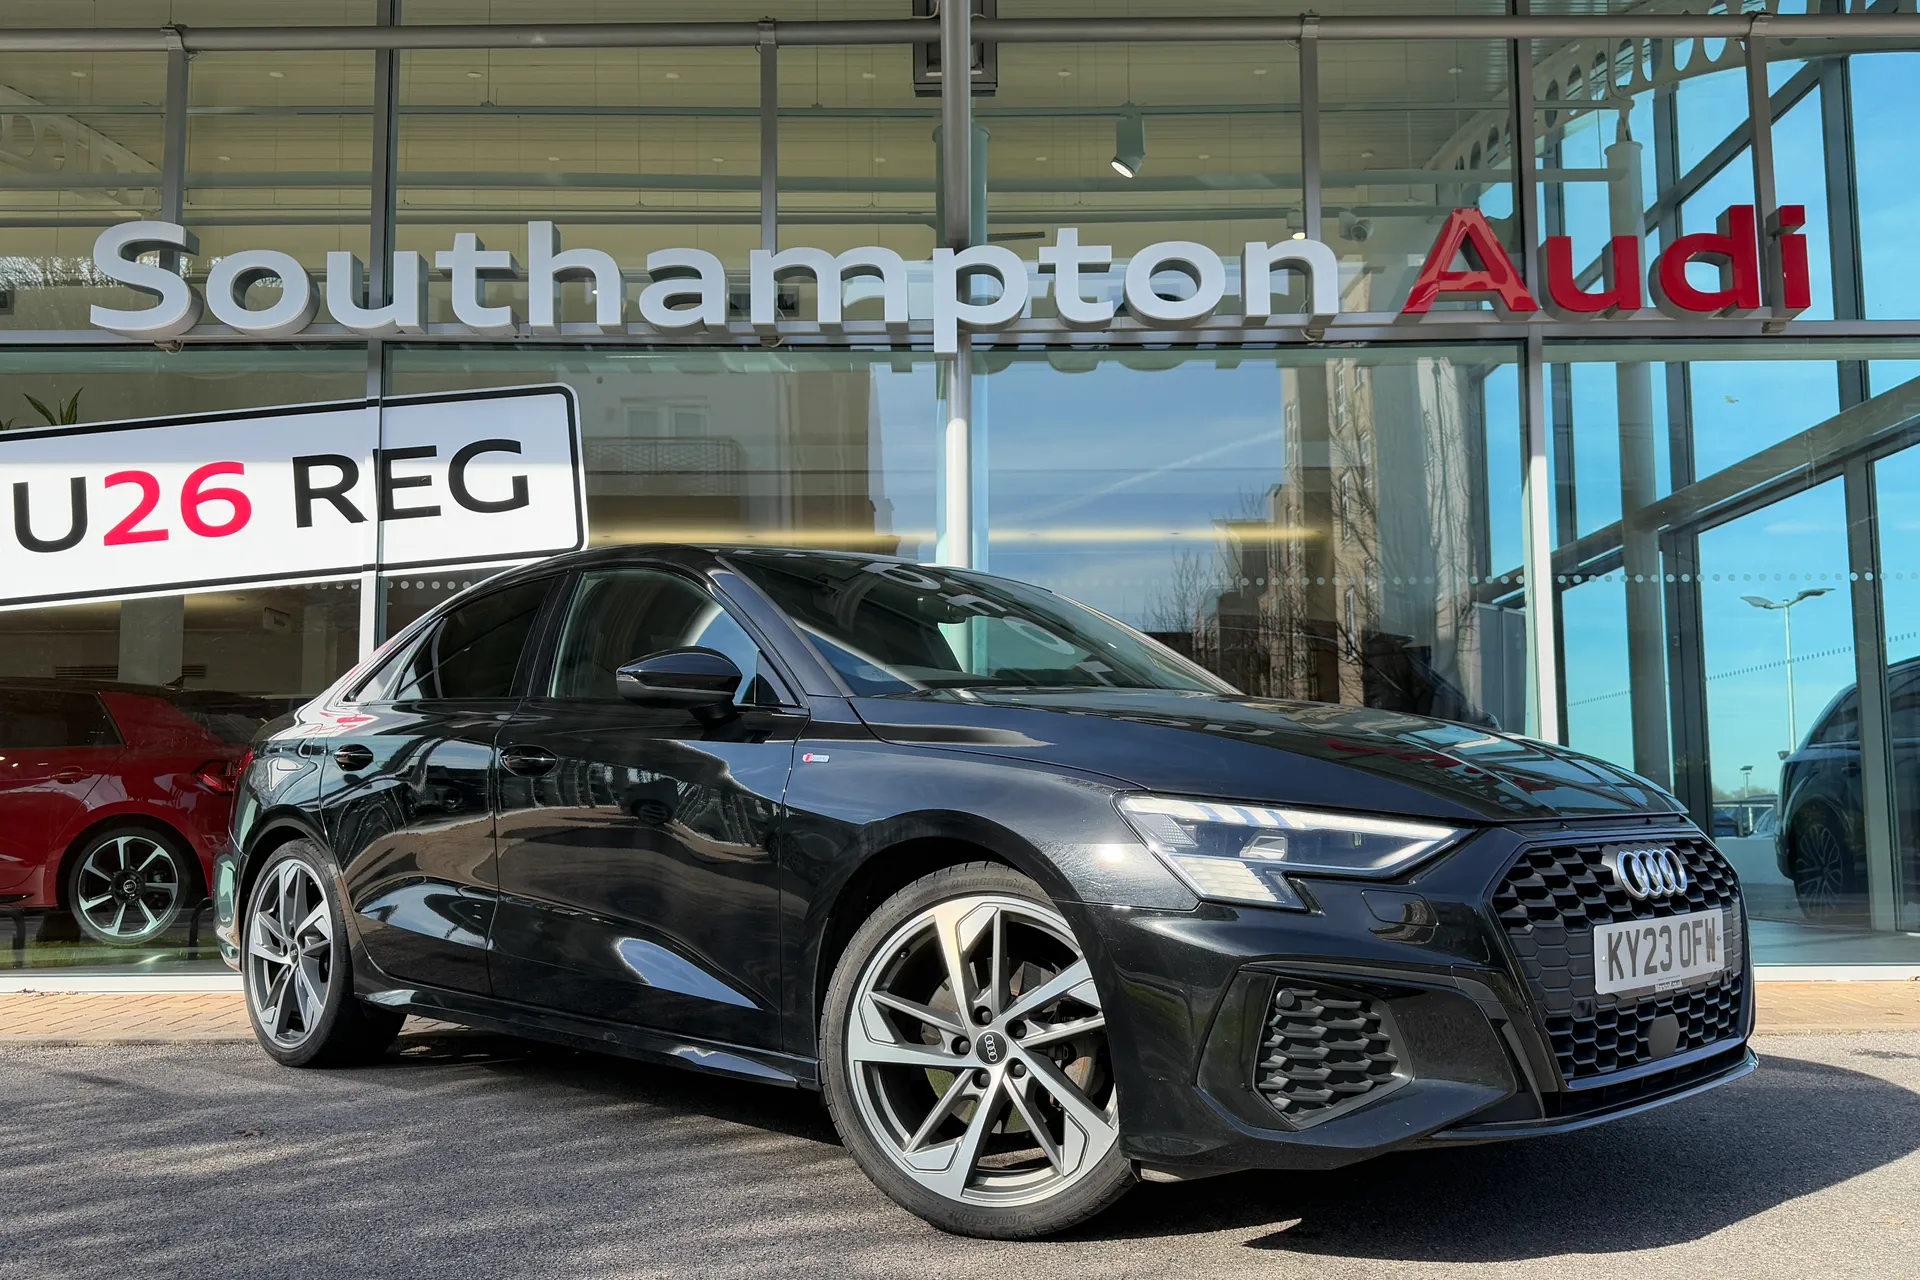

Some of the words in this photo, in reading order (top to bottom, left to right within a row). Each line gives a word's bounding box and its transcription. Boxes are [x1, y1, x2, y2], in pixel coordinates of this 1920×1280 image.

[90, 220, 1341, 356] Southampton
[1401, 204, 1812, 318] Audi
[13, 461, 253, 553] U26
[292, 438, 531, 528] REG
[951, 878, 1029, 890] BRIDGESTONE
[1607, 924, 1674, 982] KY23
[1678, 917, 1717, 969] OFW
